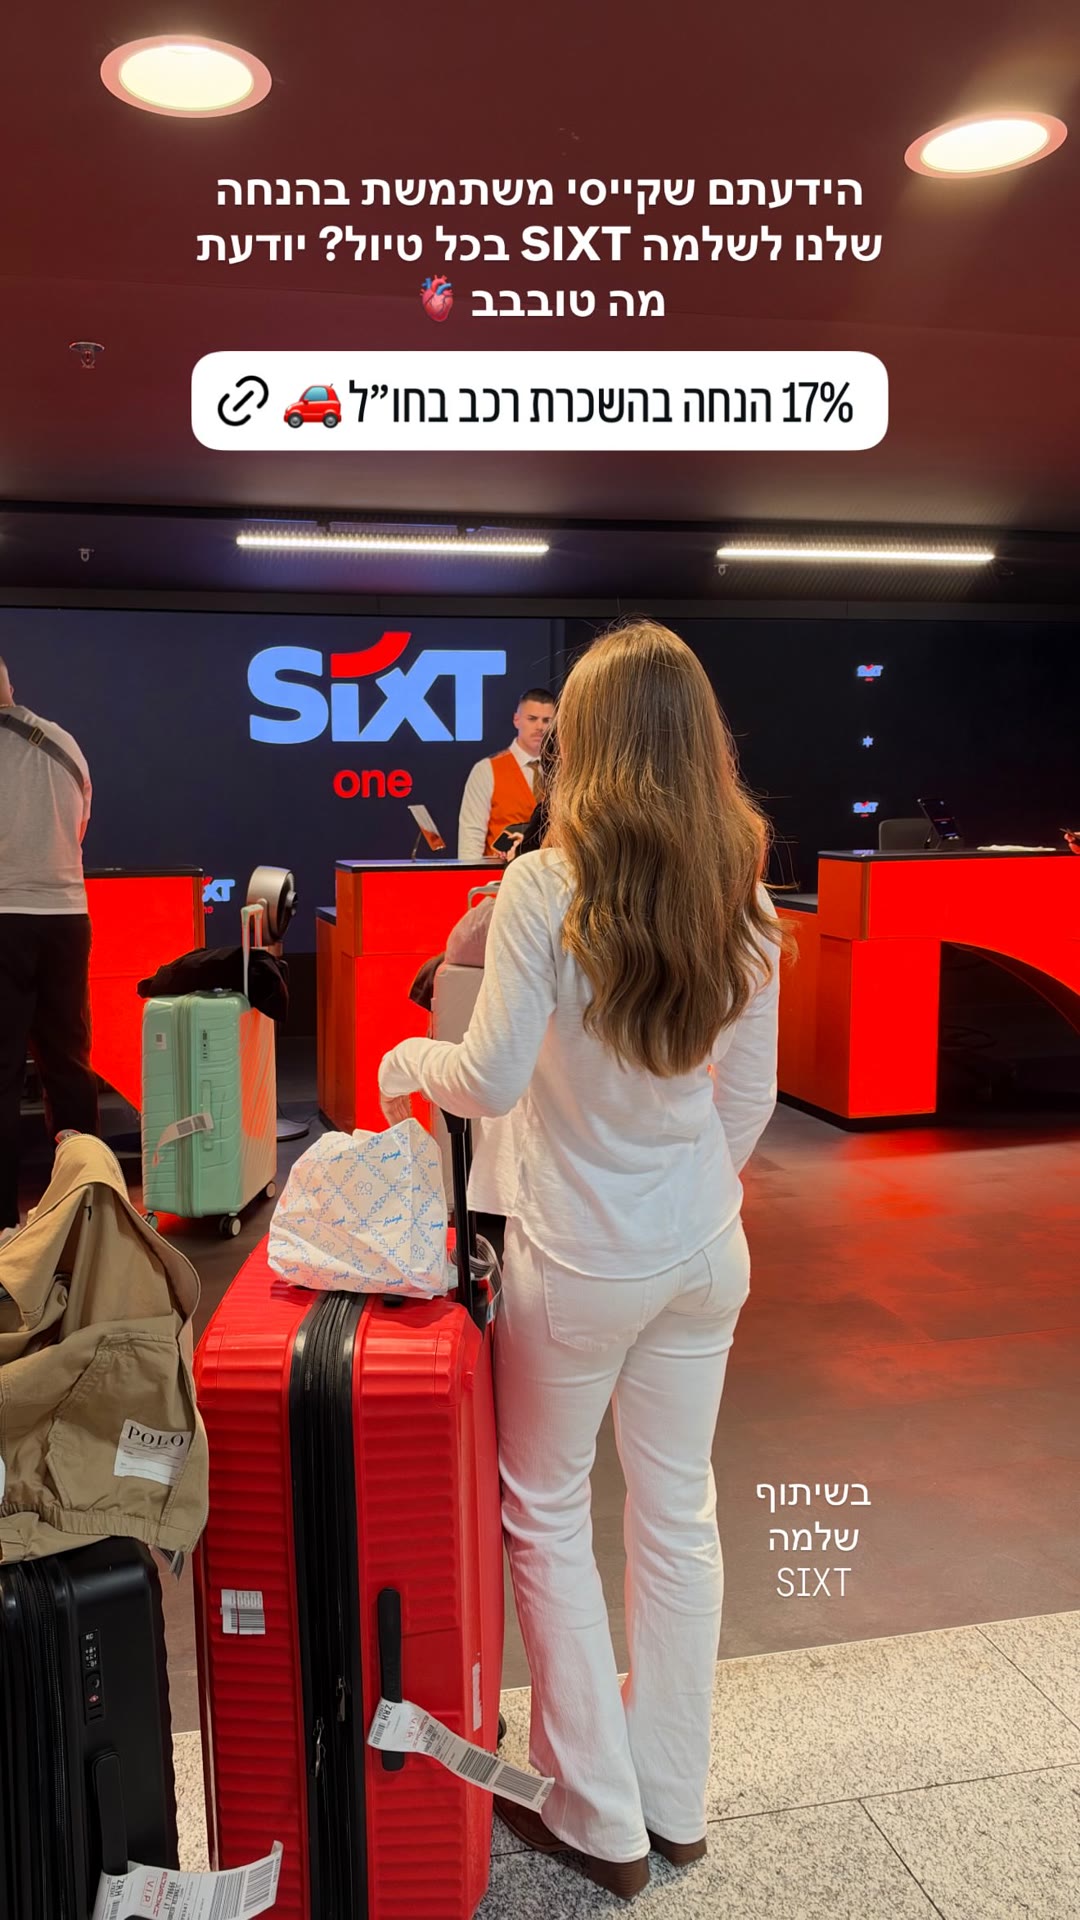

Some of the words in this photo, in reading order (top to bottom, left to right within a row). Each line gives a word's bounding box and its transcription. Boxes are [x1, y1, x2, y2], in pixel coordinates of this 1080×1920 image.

[333, 769, 413, 799] one
[127, 1425, 184, 1448] POLO
[383, 1704, 393, 1721] ZRH
[115, 1878, 125, 1897] ZRH
